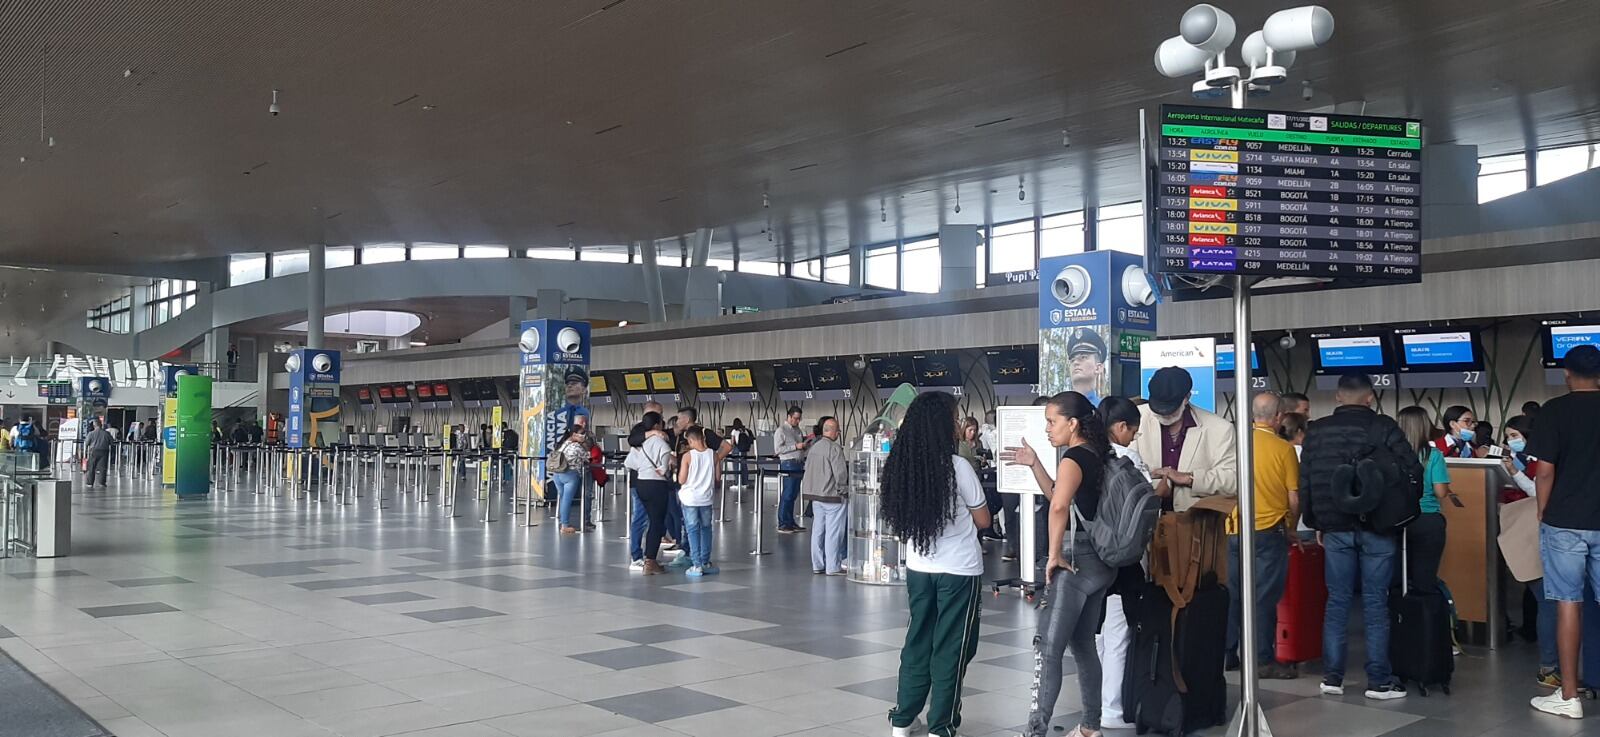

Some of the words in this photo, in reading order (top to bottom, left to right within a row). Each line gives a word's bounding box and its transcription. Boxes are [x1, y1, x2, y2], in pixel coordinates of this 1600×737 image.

[1168, 112, 1200, 120] Aeropuerto
[1200, 114, 1236, 122] Internacional
[1238, 116, 1264, 124] Matecaña
[1362, 123, 1402, 132] DEPARTURES
[1279, 144, 1311, 152] MEDELLÍN
[1277, 263, 1309, 271] MEDELLÍN
[1005, 272, 1027, 283] Pupi
[1064, 308, 1096, 317] ESTATAL
[1373, 374, 1390, 386] 26
[1463, 371, 1480, 383] 27
[1252, 377, 1266, 388] 25
[952, 386, 962, 395] 21
